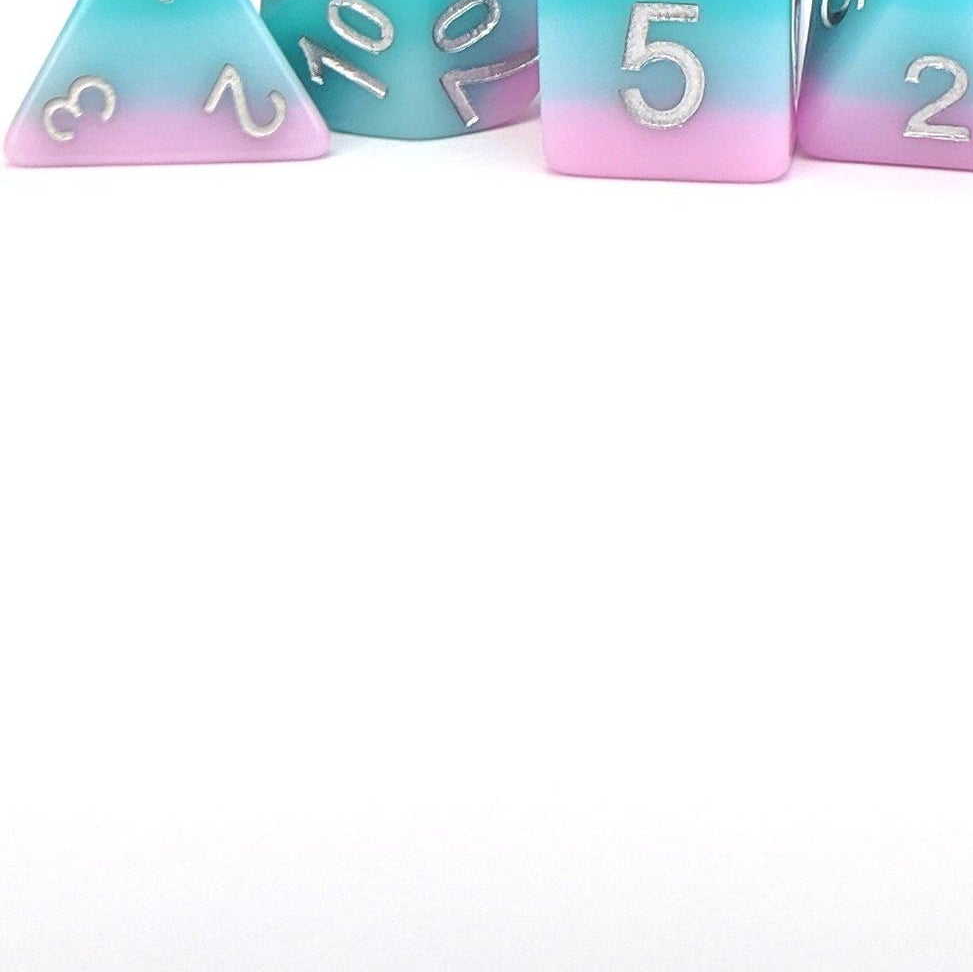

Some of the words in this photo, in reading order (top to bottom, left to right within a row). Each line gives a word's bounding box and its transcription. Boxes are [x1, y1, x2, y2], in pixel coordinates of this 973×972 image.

[203, 62, 288, 139] 2
[617, 2, 706, 129] 5
[902, 54, 972, 143] 2
[42, 74, 117, 142] 3
